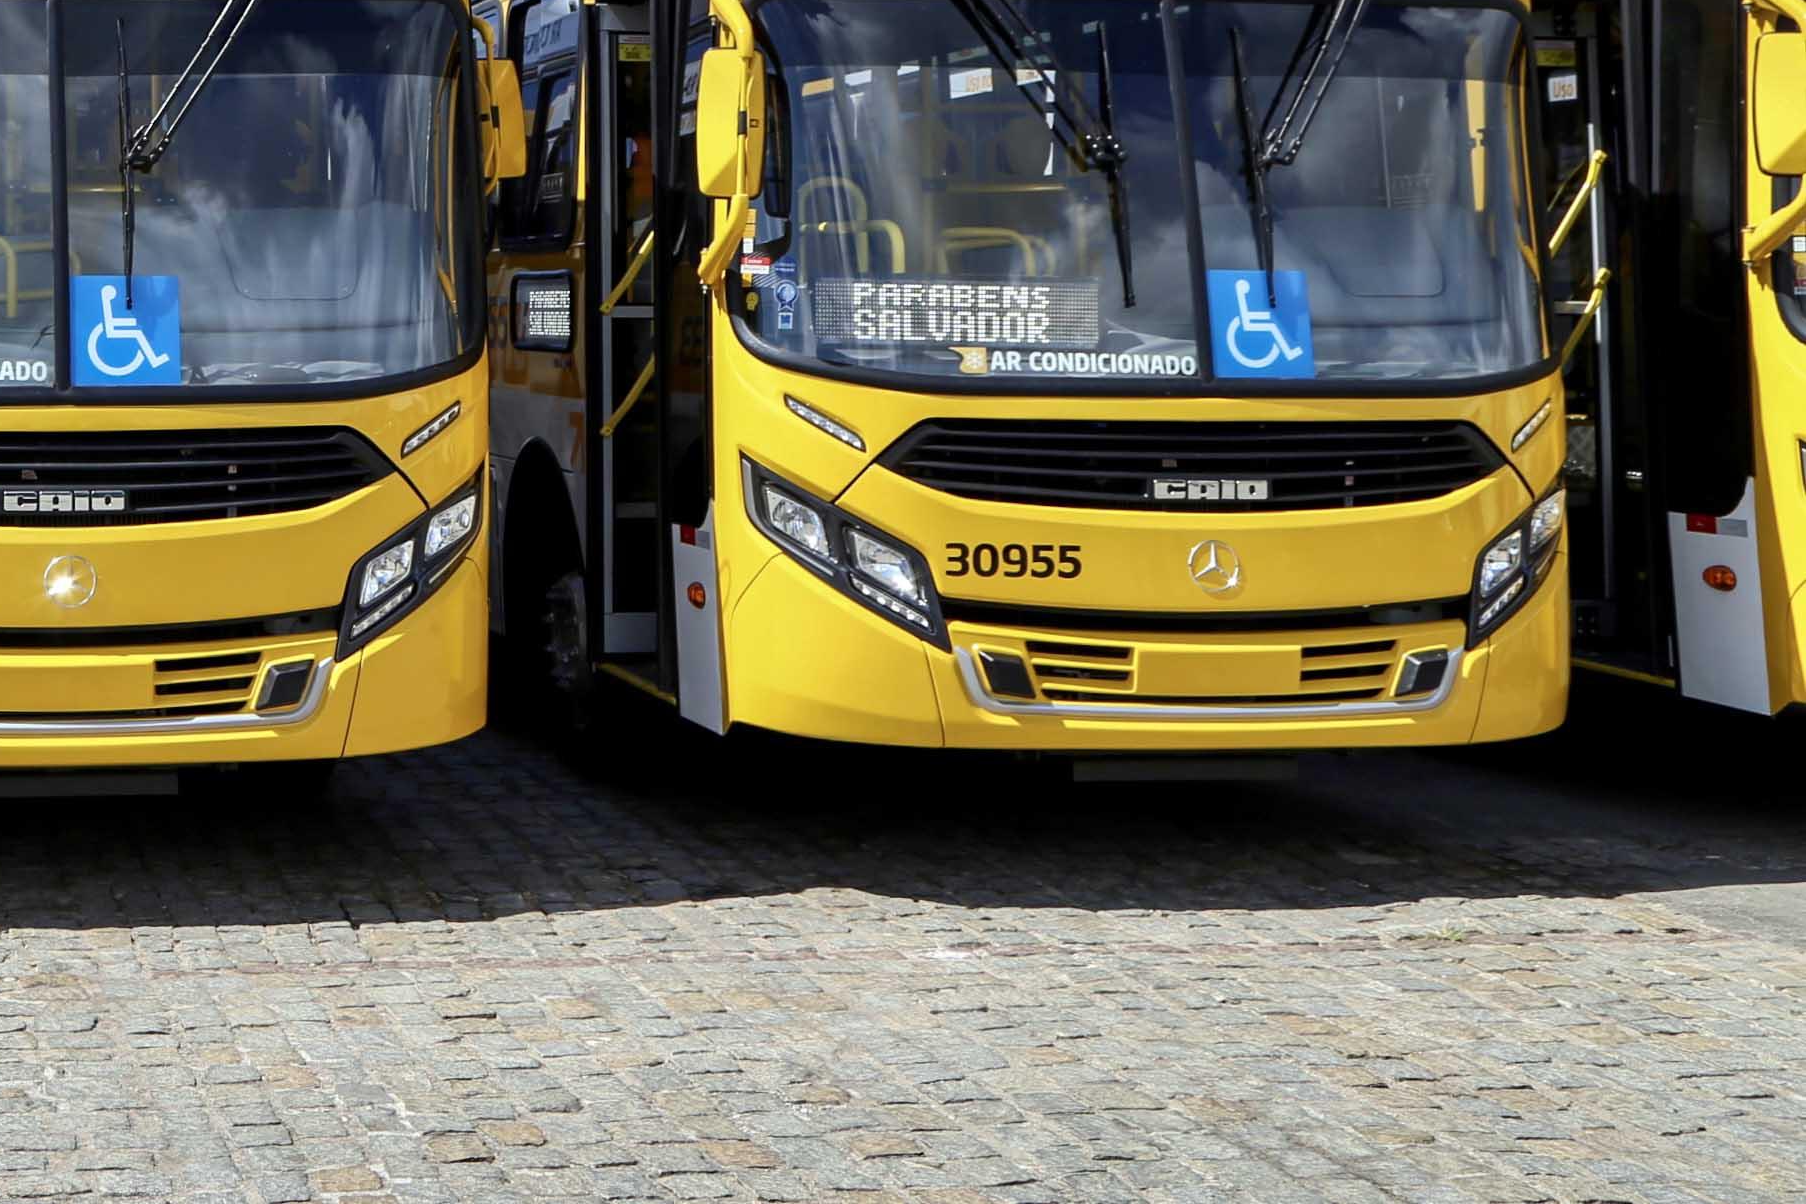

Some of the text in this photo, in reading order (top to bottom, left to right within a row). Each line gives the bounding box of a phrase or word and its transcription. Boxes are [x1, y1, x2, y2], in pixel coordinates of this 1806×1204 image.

[852, 282, 1052, 309] PARABENS
[852, 309, 1052, 343] SALVADOR
[990, 352, 1197, 376] AR CONDICIONADO
[3, 490, 126, 512] CAIO
[1154, 479, 1269, 500] CAIO
[945, 542, 1082, 579] 30955
